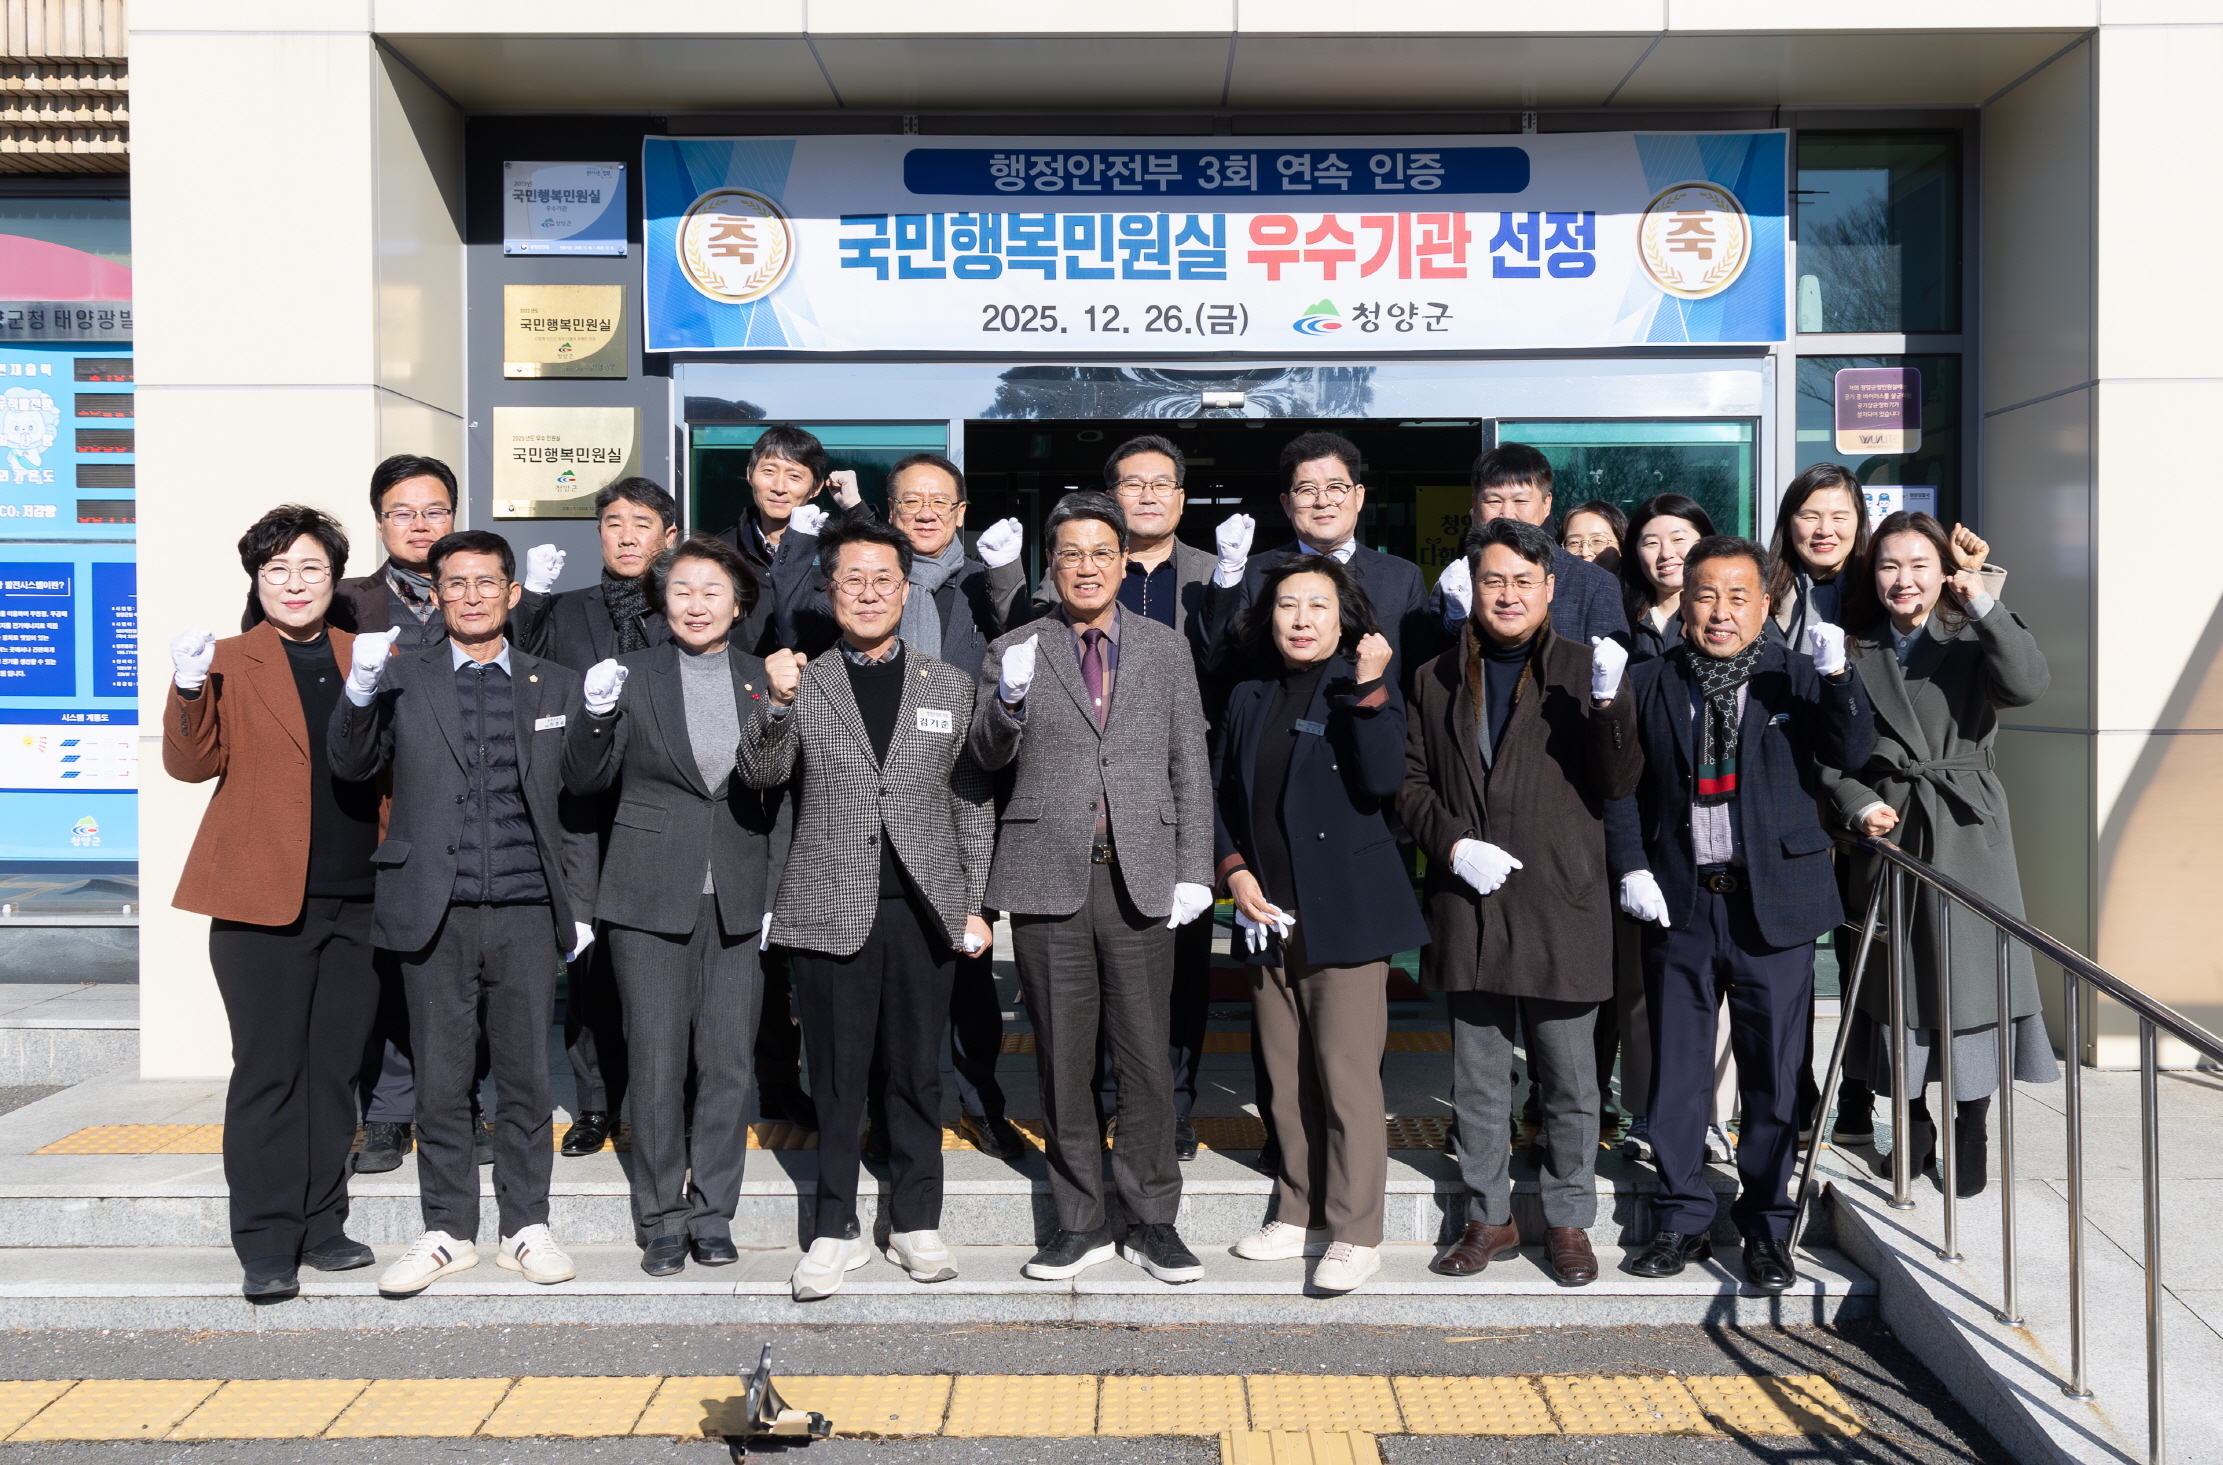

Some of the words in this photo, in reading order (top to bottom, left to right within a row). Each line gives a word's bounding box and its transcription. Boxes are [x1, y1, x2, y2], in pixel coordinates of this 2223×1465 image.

[990, 153, 1183, 192] 행정안전부
[1197, 154, 1258, 191] 3회
[1276, 153, 1352, 191] 연속
[1368, 152, 1446, 190] 인증
[511, 188, 601, 204] 국민행복민원실
[707, 216, 760, 266] 축
[838, 211, 1228, 281] 국민행복민원실
[1246, 211, 1472, 281] 우수기관
[1488, 210, 1597, 280] 선정
[1665, 209, 1717, 260] 축
[0, 309, 45, 330] 군청
[519, 317, 611, 332] 국민행복민원실
[981, 303, 1068, 335] 2025.
[1084, 303, 1130, 335] 12.
[1144, 302, 1250, 338] 26.(금)
[1351, 300, 1455, 334] 청양군
[512, 447, 622, 464] 국민행복민원실
[919, 717, 949, 729] 김기준
[70, 836, 102, 847] 청양군
